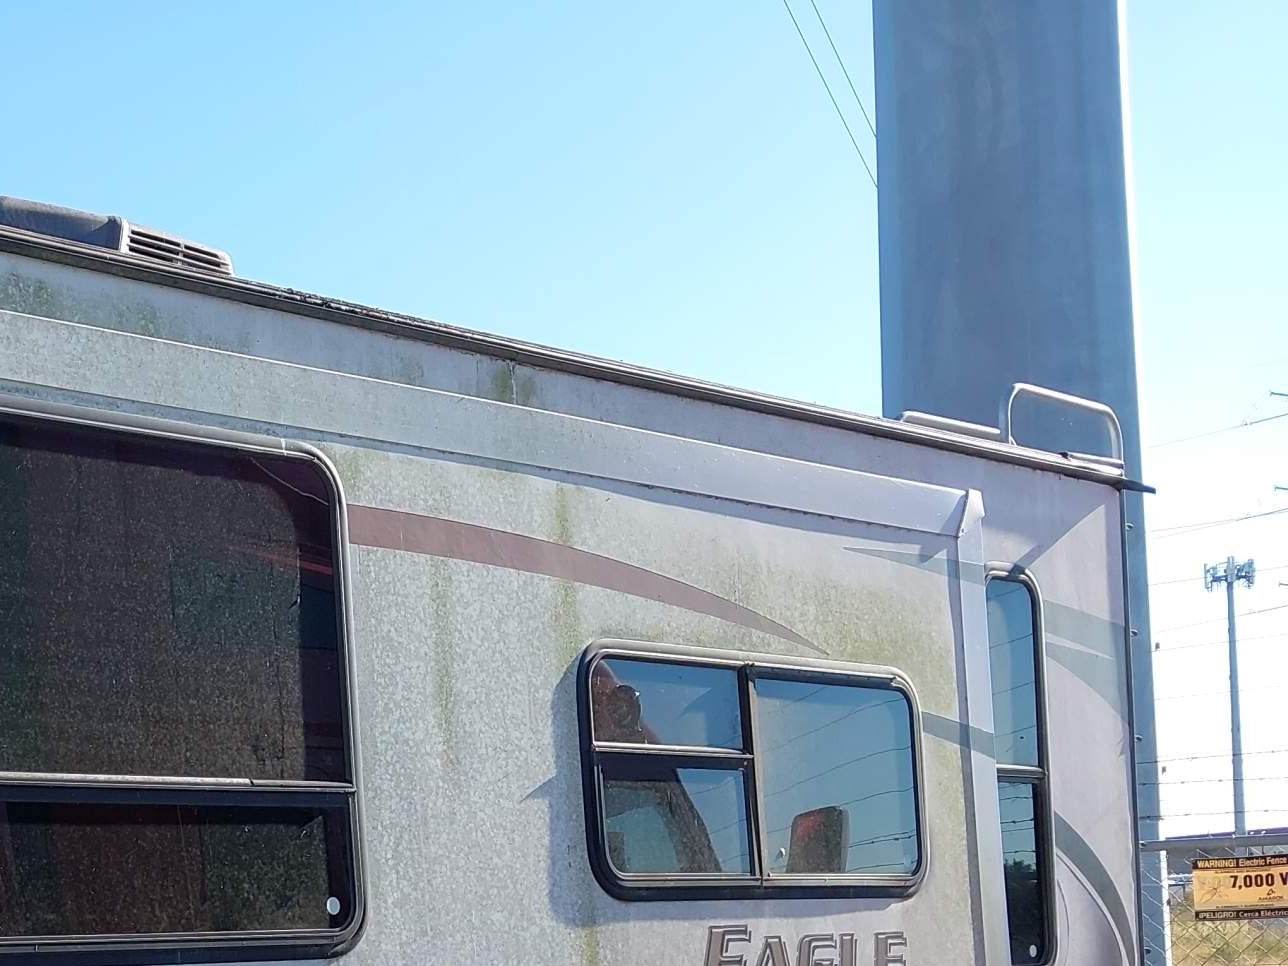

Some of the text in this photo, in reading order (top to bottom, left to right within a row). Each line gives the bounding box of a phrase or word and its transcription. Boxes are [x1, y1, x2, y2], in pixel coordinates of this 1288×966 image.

[1197, 859, 1237, 868] WARNING!
[1239, 858, 1265, 866] Electric
[1230, 873, 1274, 890] 7,000
